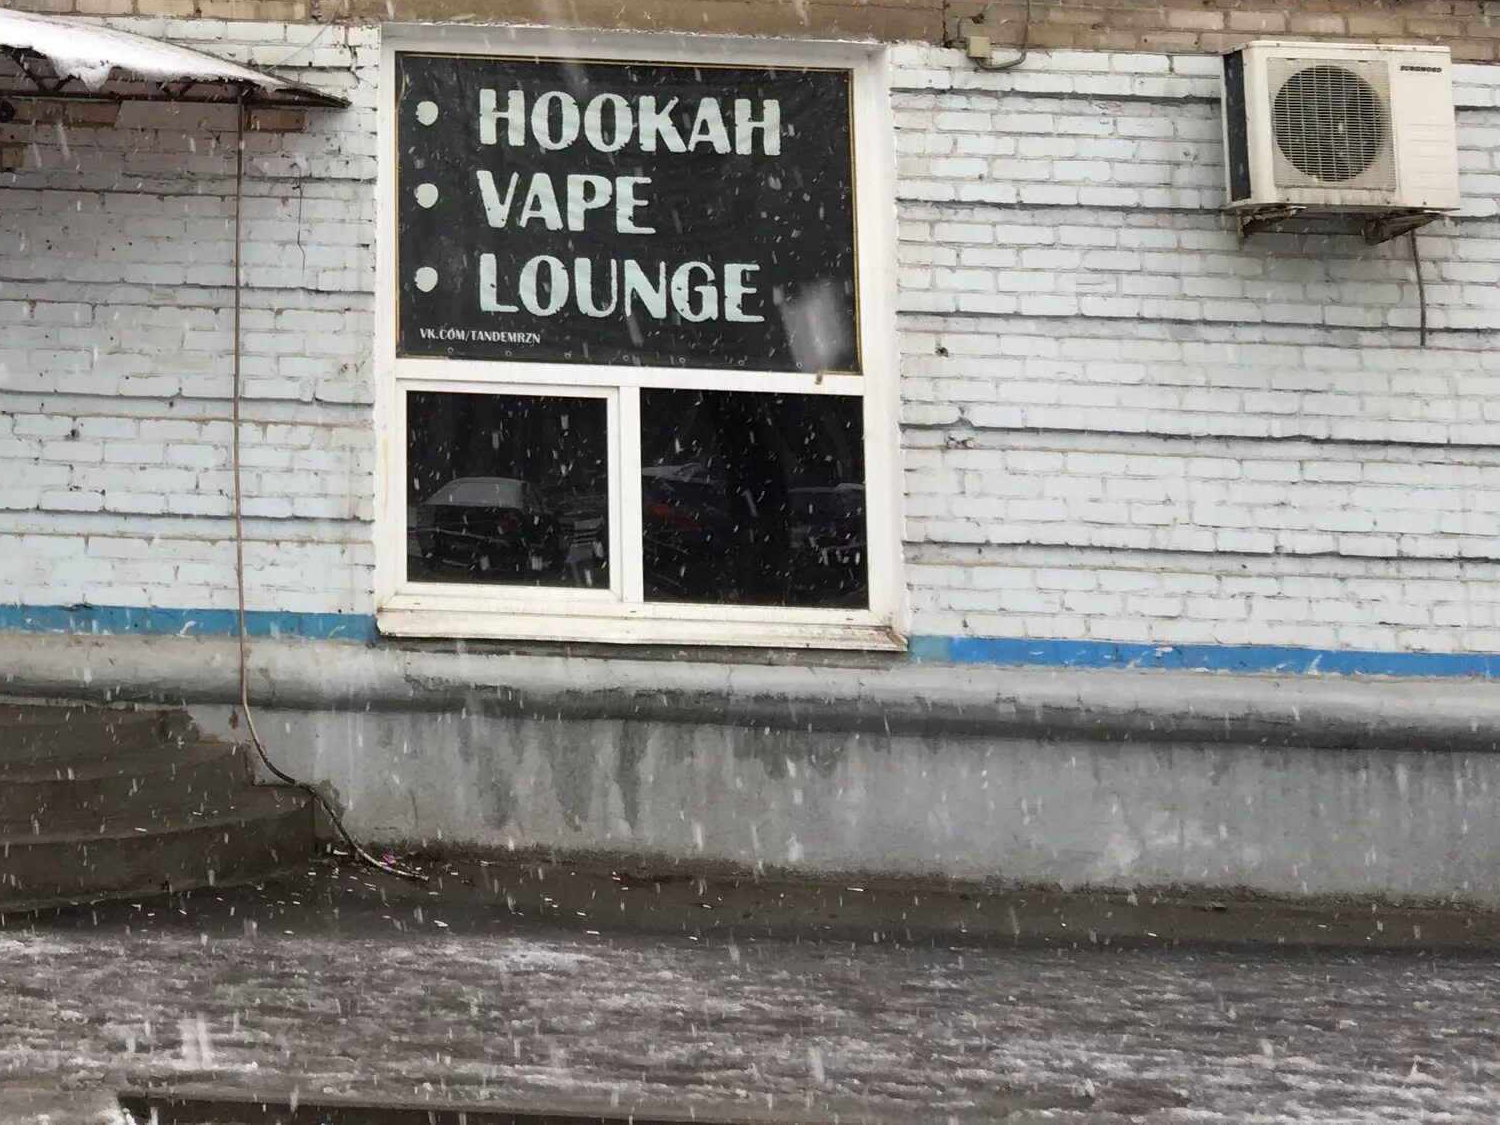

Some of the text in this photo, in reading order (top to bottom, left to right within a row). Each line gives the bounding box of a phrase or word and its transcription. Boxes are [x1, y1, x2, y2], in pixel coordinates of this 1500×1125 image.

[479, 88, 782, 156] HOOKAH
[476, 170, 657, 234] VAPE
[479, 252, 765, 322] LOUNGE
[419, 328, 541, 344] VK.COM/TANDEMRZN
